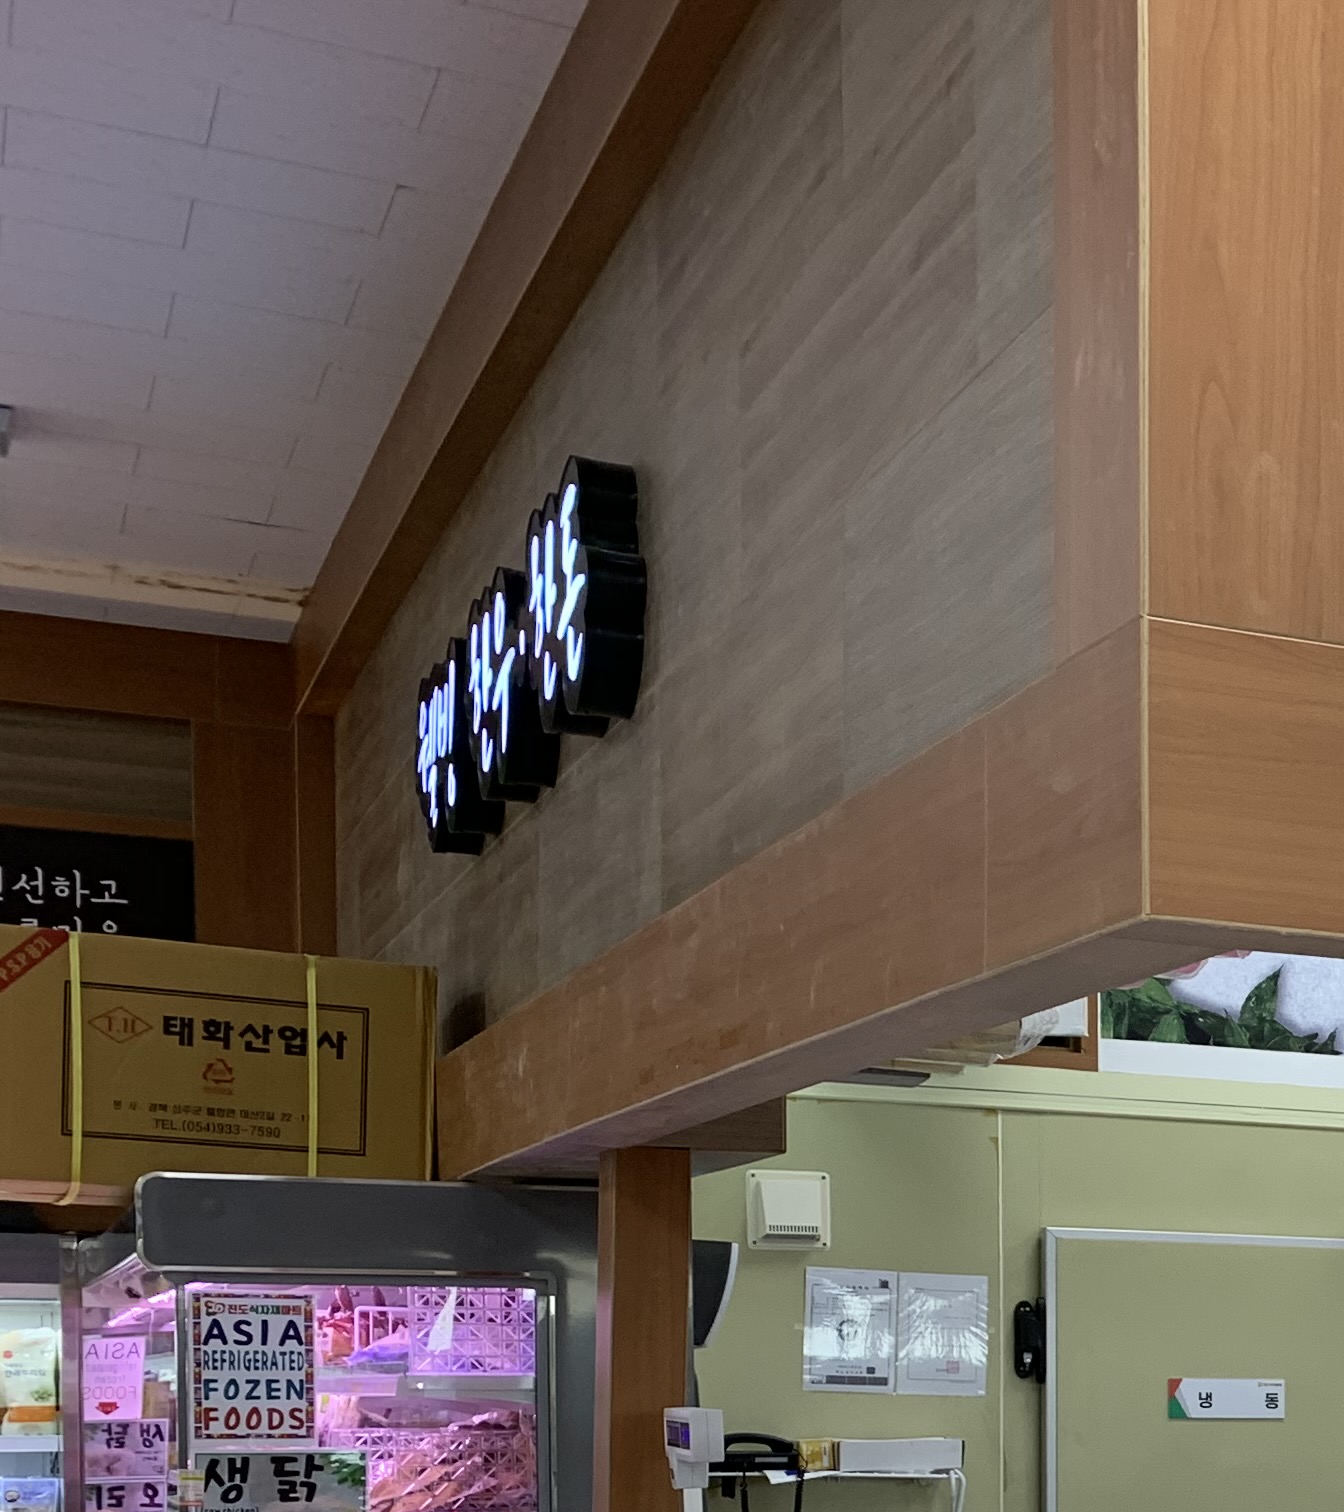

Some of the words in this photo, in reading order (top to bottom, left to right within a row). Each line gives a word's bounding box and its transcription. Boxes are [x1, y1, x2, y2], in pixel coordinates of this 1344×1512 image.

[163, 1014, 347, 1060] 태화산업사
[202, 1318, 304, 1347] ASIA
[202, 1350, 305, 1372] REFRIGERATED
[203, 1378, 304, 1401] FOZEN
[203, 1406, 305, 1431] FOODS
